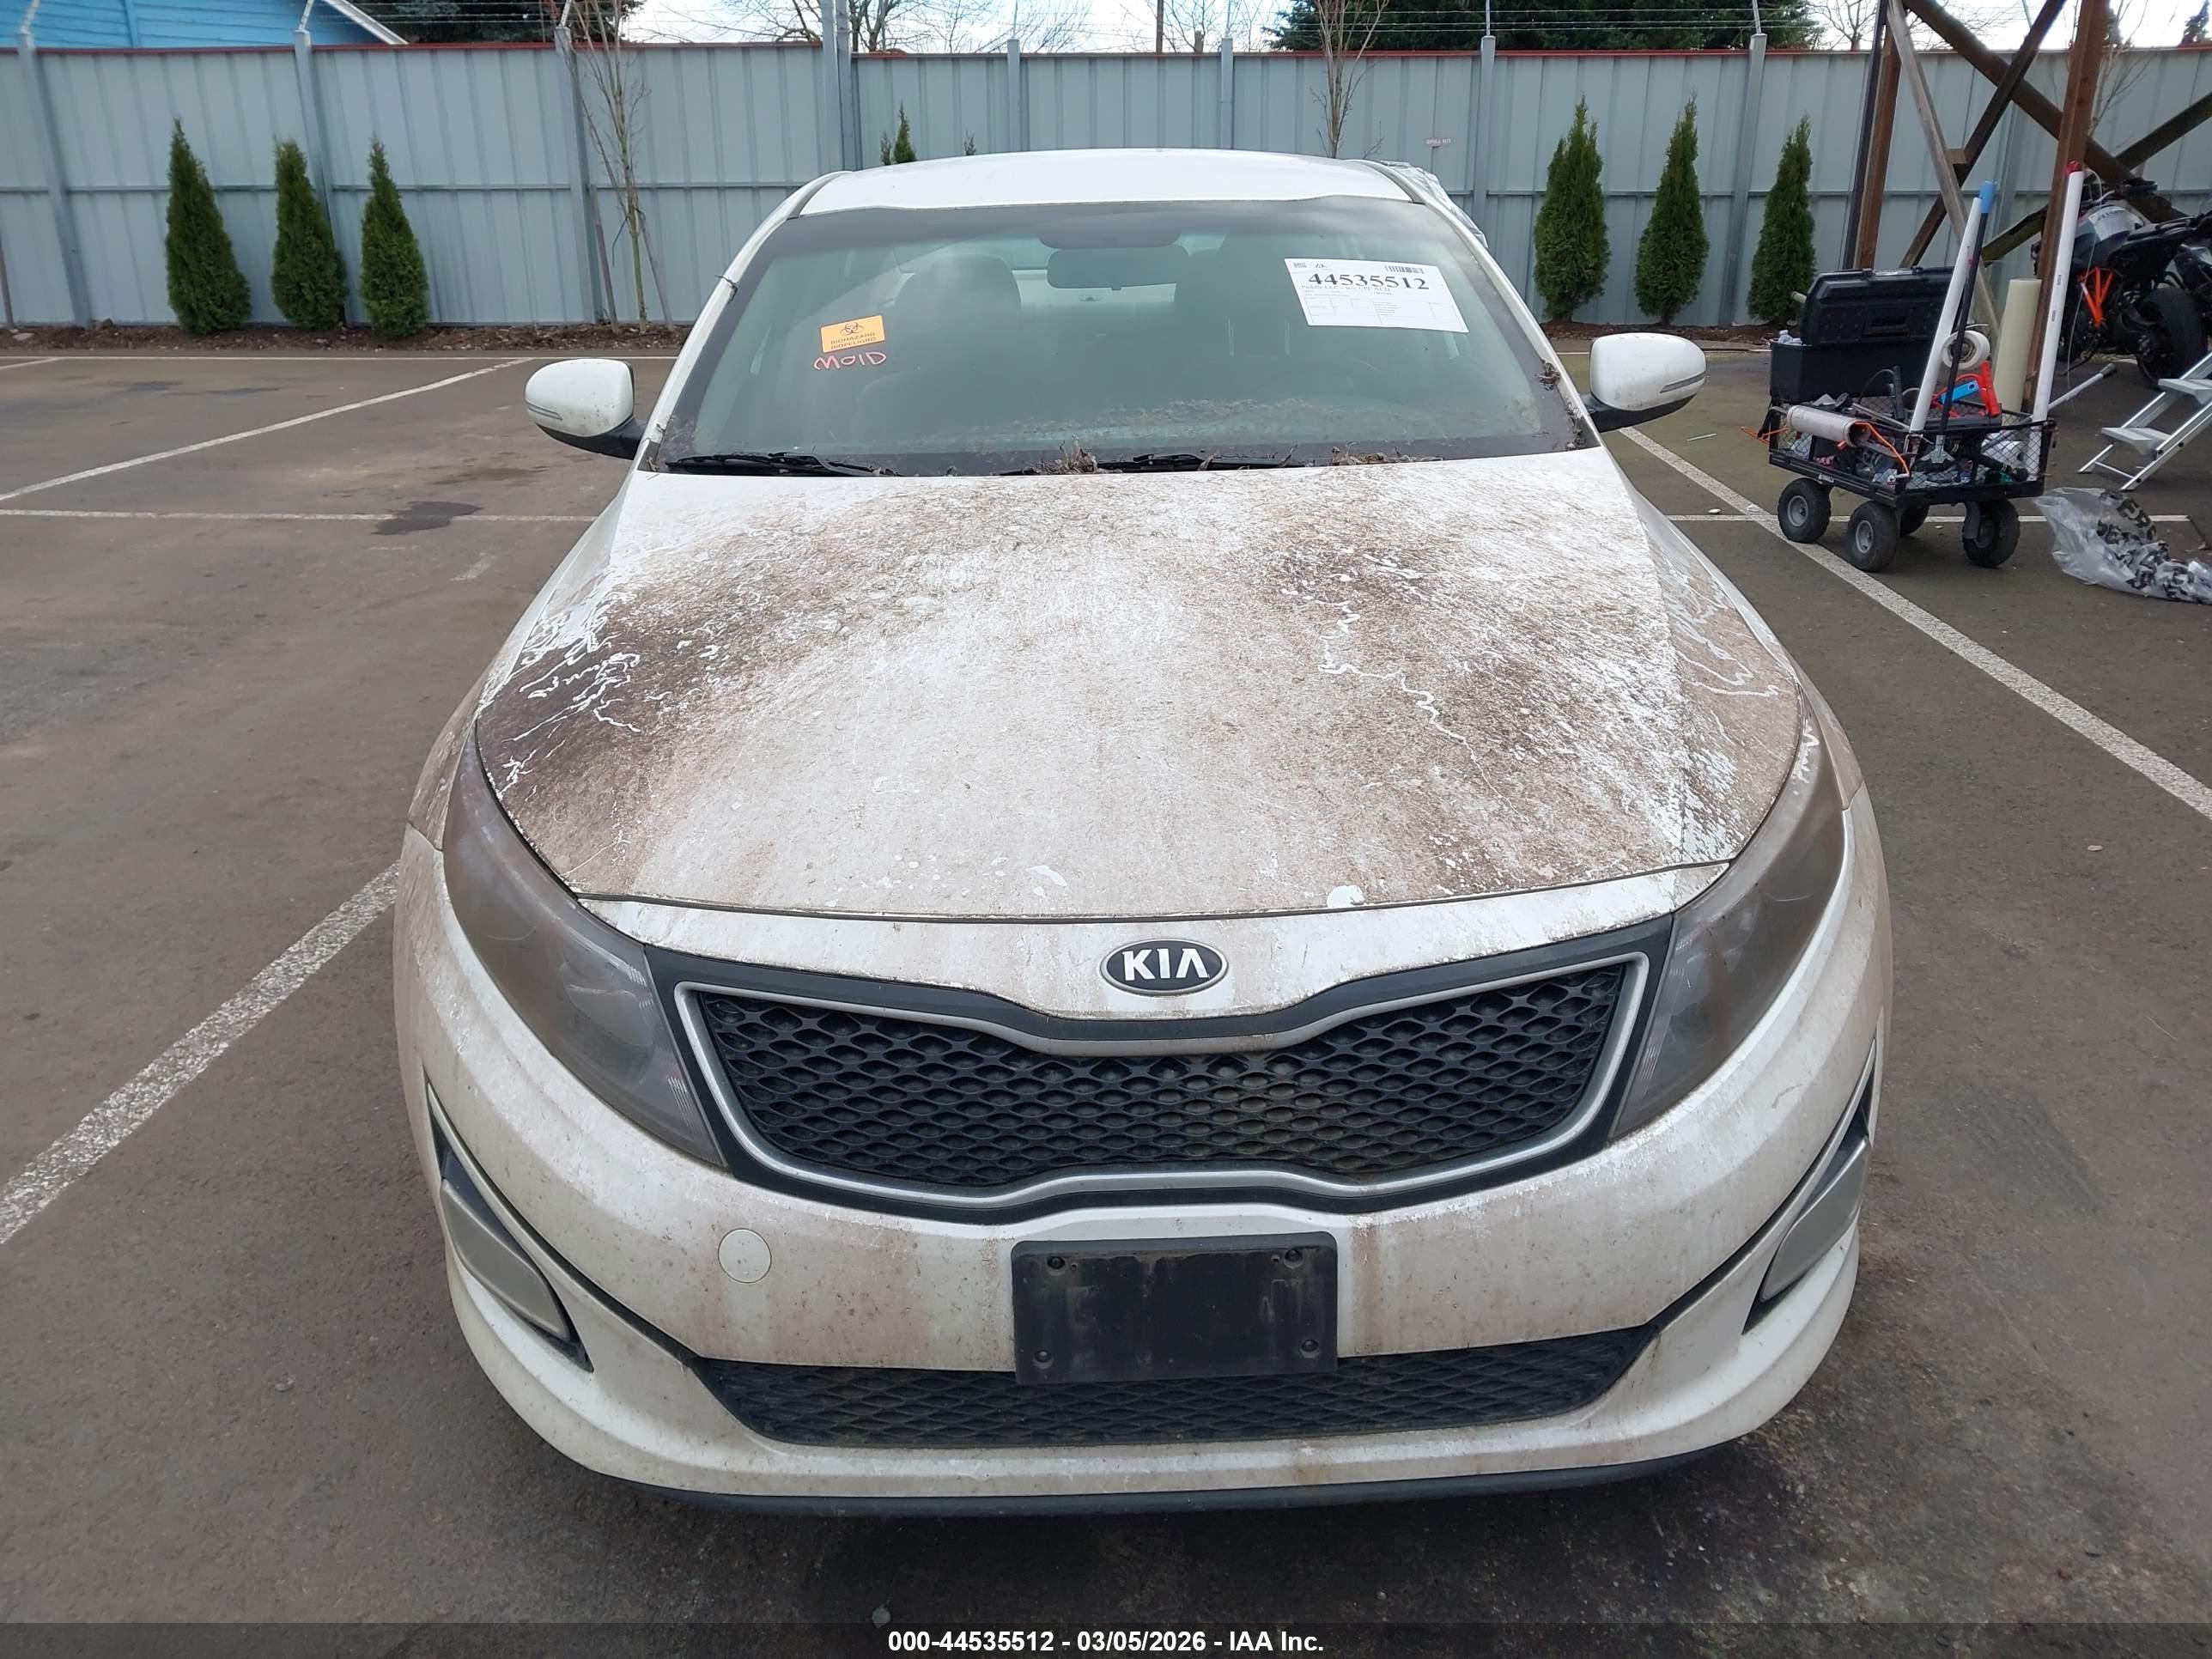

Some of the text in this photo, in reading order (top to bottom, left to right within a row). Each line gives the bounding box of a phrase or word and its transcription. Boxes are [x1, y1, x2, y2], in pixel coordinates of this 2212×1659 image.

[1308, 273, 1430, 290] 44535512
[830, 331, 876, 344] BIOHAZARD
[830, 337, 877, 349] BIOPELIGRO
[1122, 948, 1210, 981] KIA
